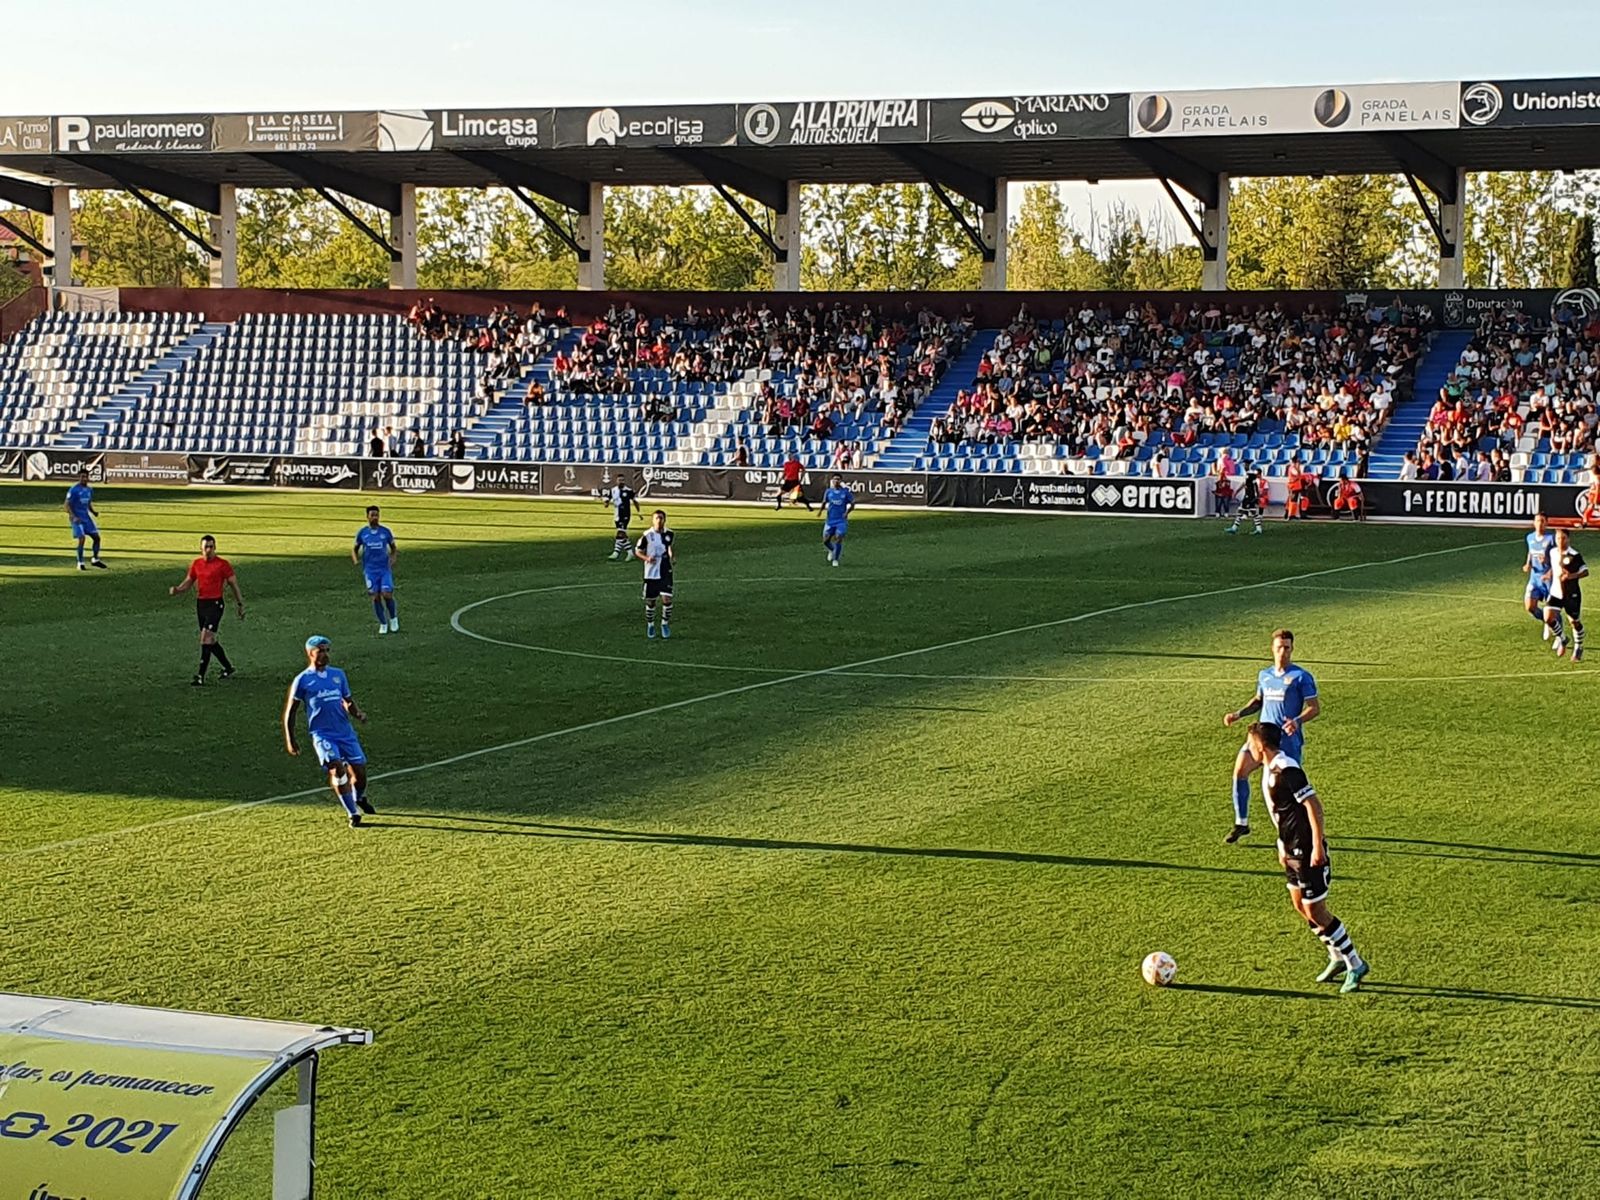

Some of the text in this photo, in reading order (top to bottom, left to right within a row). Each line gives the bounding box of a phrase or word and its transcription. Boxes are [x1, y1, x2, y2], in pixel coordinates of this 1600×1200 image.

[1013, 95, 1109, 113] MARIANO
[1183, 105, 1229, 116] GRADA
[1362, 100, 1408, 111] GRADA
[260, 114, 334, 126] LA CASETA
[442, 111, 538, 136] Limcasa
[629, 116, 704, 136] ecotisa
[1182, 115, 1268, 131] PANELAIS
[1361, 109, 1451, 126] PANELAIS
[95, 120, 205, 143] paularomero
[674, 134, 702, 145] grupo
[790, 127, 878, 144] AUTOESCUELA
[504, 135, 538, 147] Grupo
[476, 467, 539, 484] JUÁREZ
[885, 480, 924, 495] Parada
[1029, 482, 1085, 494] Ayuntamiento
[1041, 494, 1085, 506] Salamanca
[1122, 484, 1192, 510] errea
[1426, 489, 1540, 515] FEDERACIÓN
[49, 1070, 73, 1082] es
[63, 1070, 215, 1097] permanecer
[48, 1114, 180, 1154] 2021
